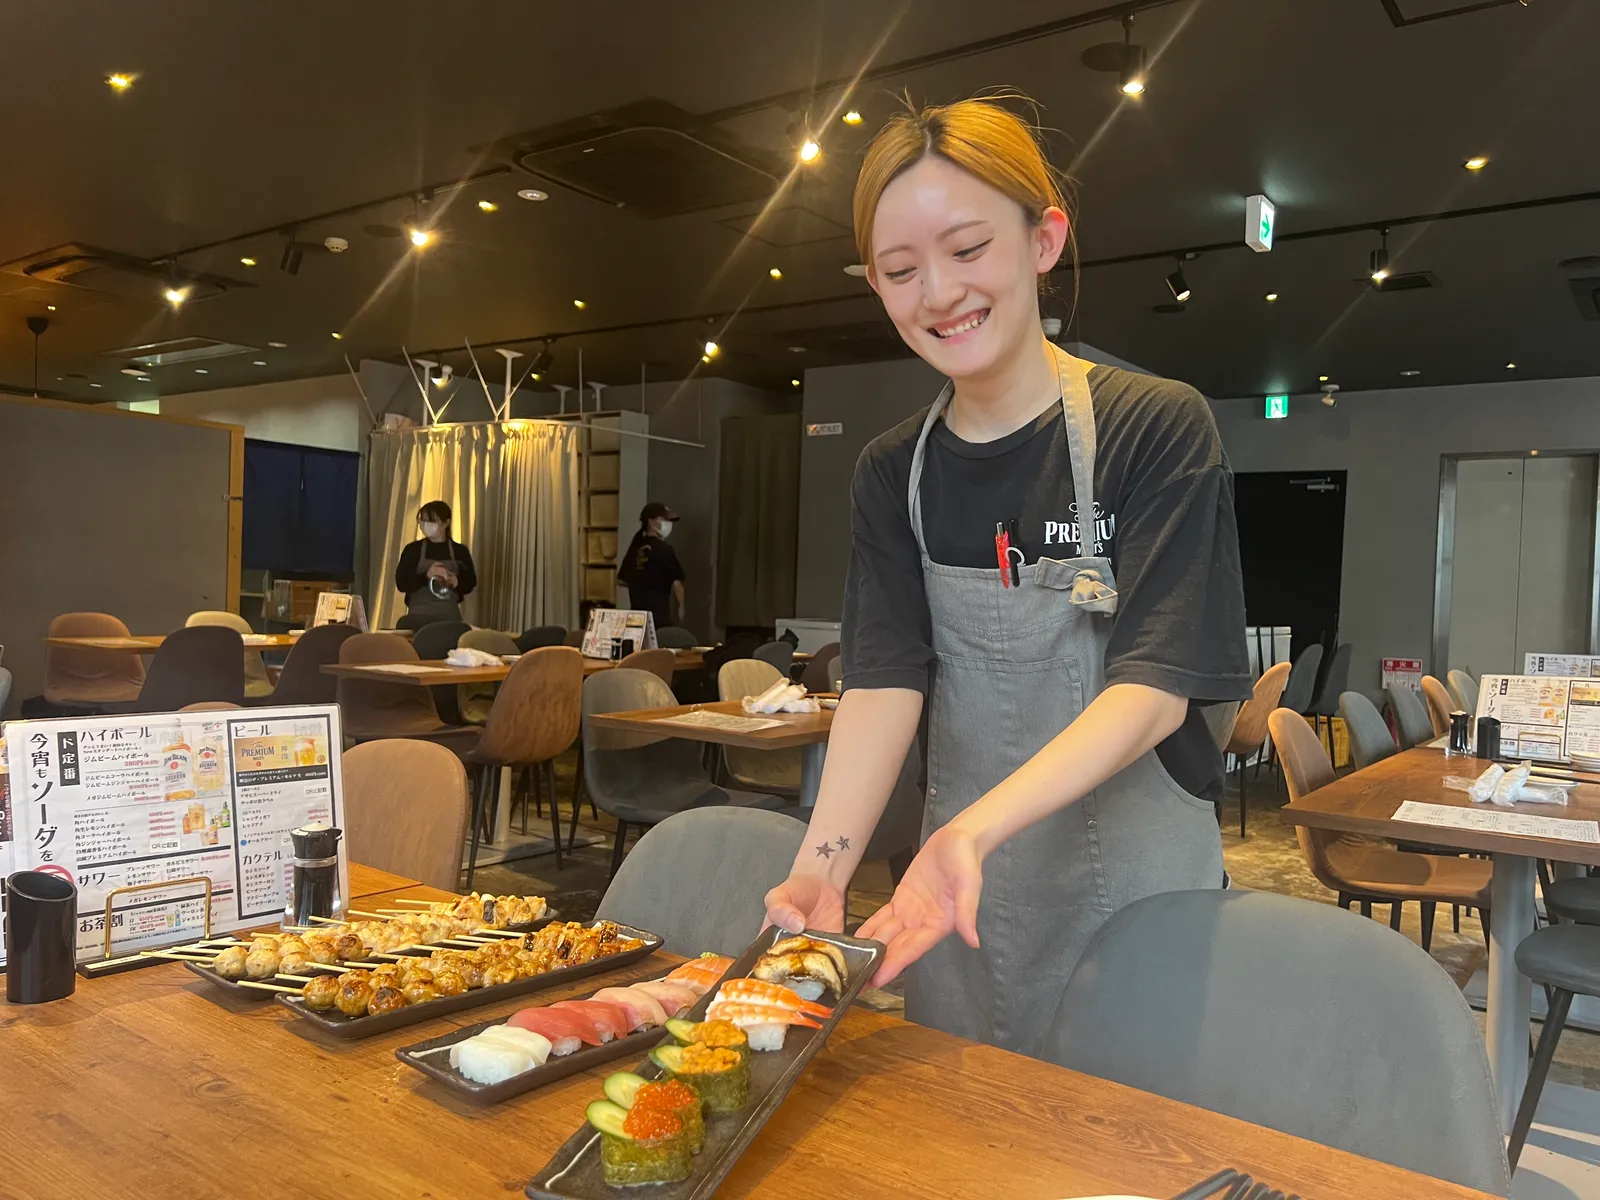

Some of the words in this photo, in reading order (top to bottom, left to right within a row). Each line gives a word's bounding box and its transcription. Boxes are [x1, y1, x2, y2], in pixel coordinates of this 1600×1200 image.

[81, 726, 152, 742] ハイボール
[235, 724, 272, 738] ビール
[84, 753, 150, 763] ジムビームハイボール
[241, 746, 275, 757] PREMIUM
[61, 738, 76, 780] ド定番
[29, 733, 58, 862] 今宵もソーダを
[243, 851, 284, 865] カクテル
[126, 863, 161, 872] プレーンサワー
[77, 871, 121, 887] サワー
[127, 871, 157, 879] レモンサワー
